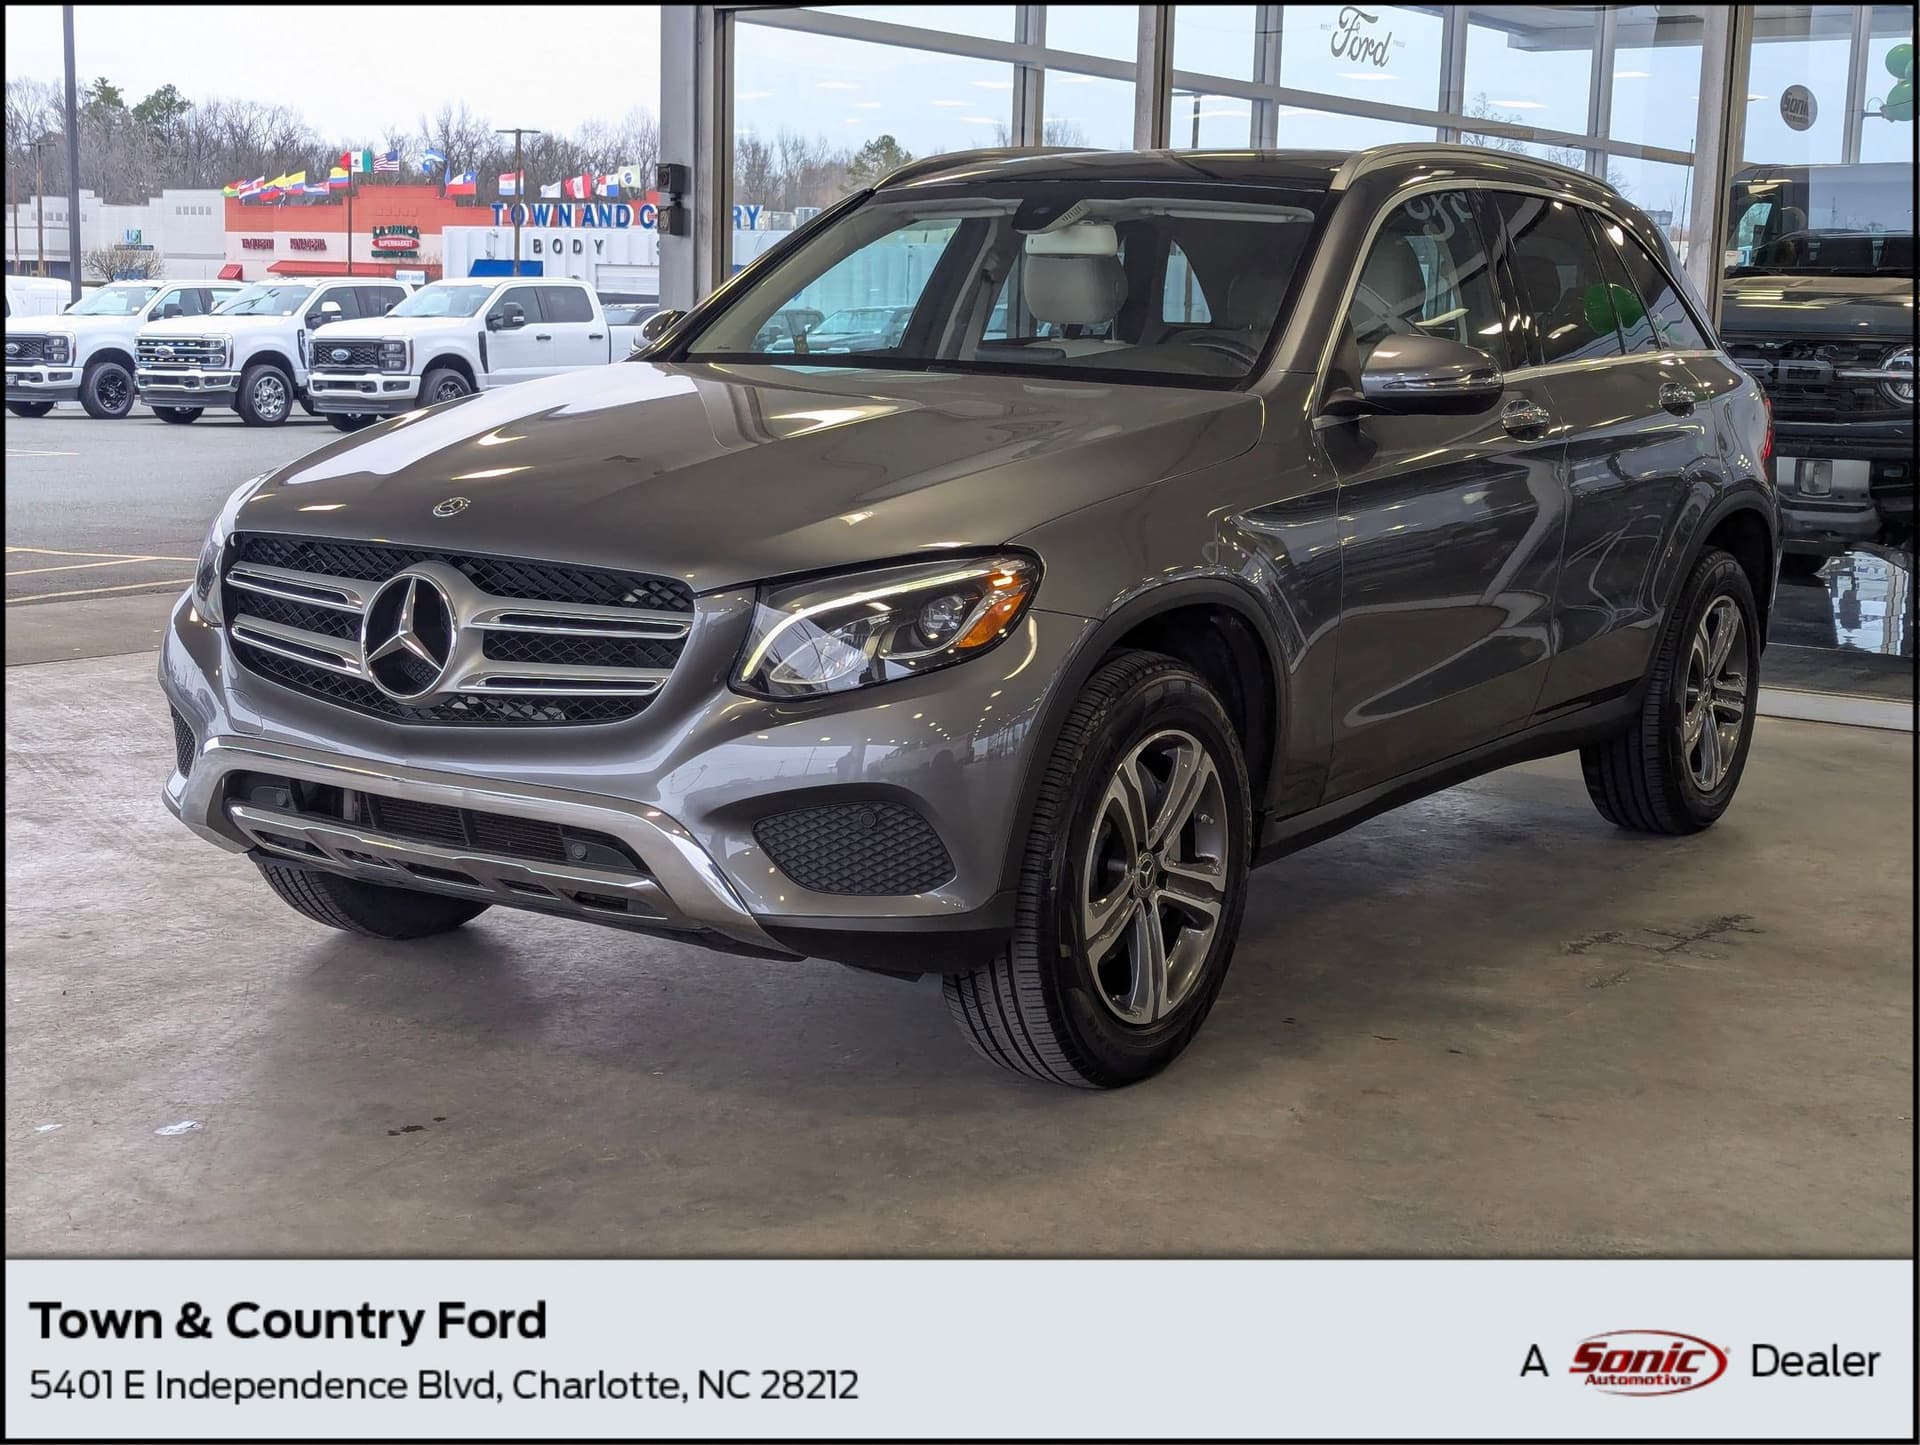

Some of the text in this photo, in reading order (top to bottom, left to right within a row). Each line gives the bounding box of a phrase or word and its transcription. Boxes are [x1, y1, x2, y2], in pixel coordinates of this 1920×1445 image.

[1331, 6, 1392, 68] Ford
[491, 203, 573, 228] TOWN
[582, 203, 633, 228] AND
[533, 238, 605, 255] BODY
